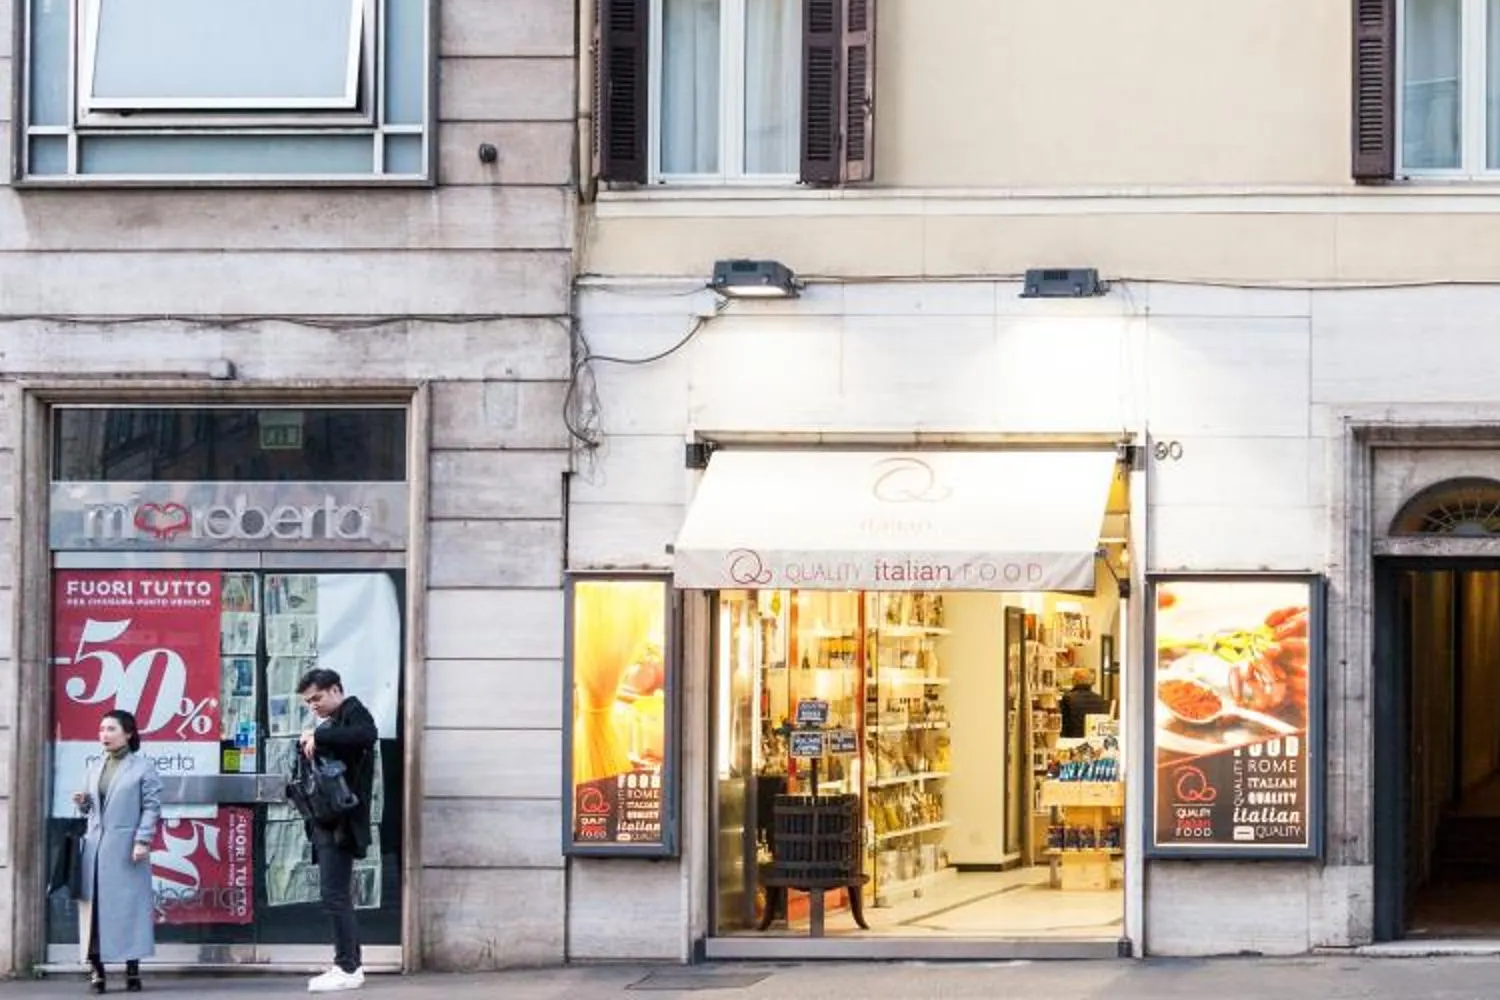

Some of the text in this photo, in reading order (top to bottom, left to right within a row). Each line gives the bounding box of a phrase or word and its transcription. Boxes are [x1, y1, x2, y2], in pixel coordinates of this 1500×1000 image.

[1154, 441, 1184, 461] 90
[785, 562, 861, 583] QUALITY
[874, 559, 951, 581] italian
[961, 562, 1044, 582] FOOD
[67, 581, 212, 596] FUORI TUTTO
[1247, 760, 1297, 773] ROME
[1248, 777, 1297, 789] ITALIAN
[1248, 792, 1297, 805] QUALITY
[1176, 807, 1211, 819] QUALITY
[1233, 808, 1300, 823] italian
[1176, 828, 1212, 837] FOOD
[1256, 826, 1300, 838] QUALITY
